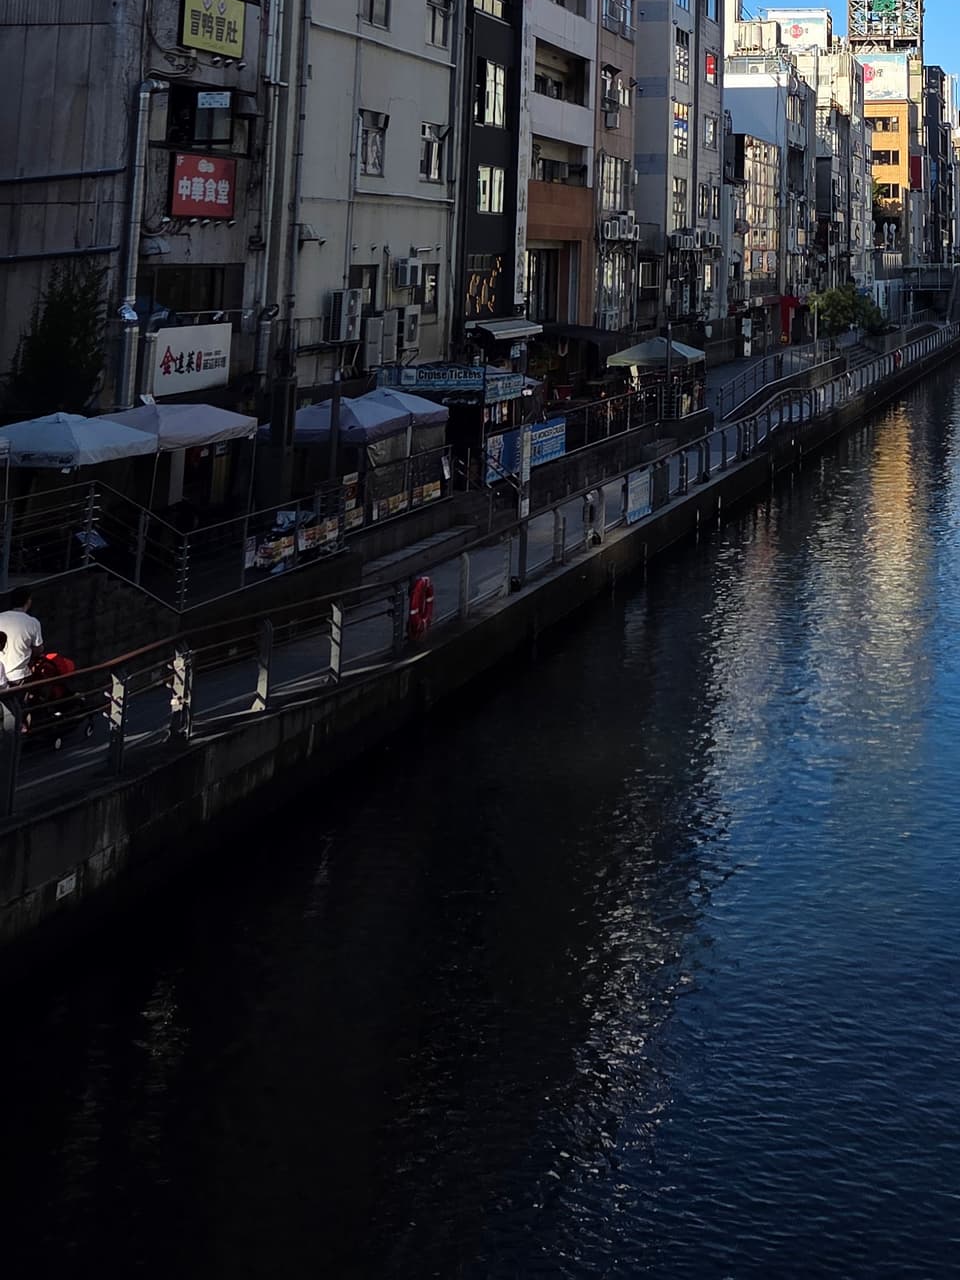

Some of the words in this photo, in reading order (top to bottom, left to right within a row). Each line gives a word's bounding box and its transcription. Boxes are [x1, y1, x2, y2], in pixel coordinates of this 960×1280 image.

[178, 175, 230, 205] 中華食堂
[417, 369, 448, 380] Cruise
[450, 369, 482, 380] Tickets
